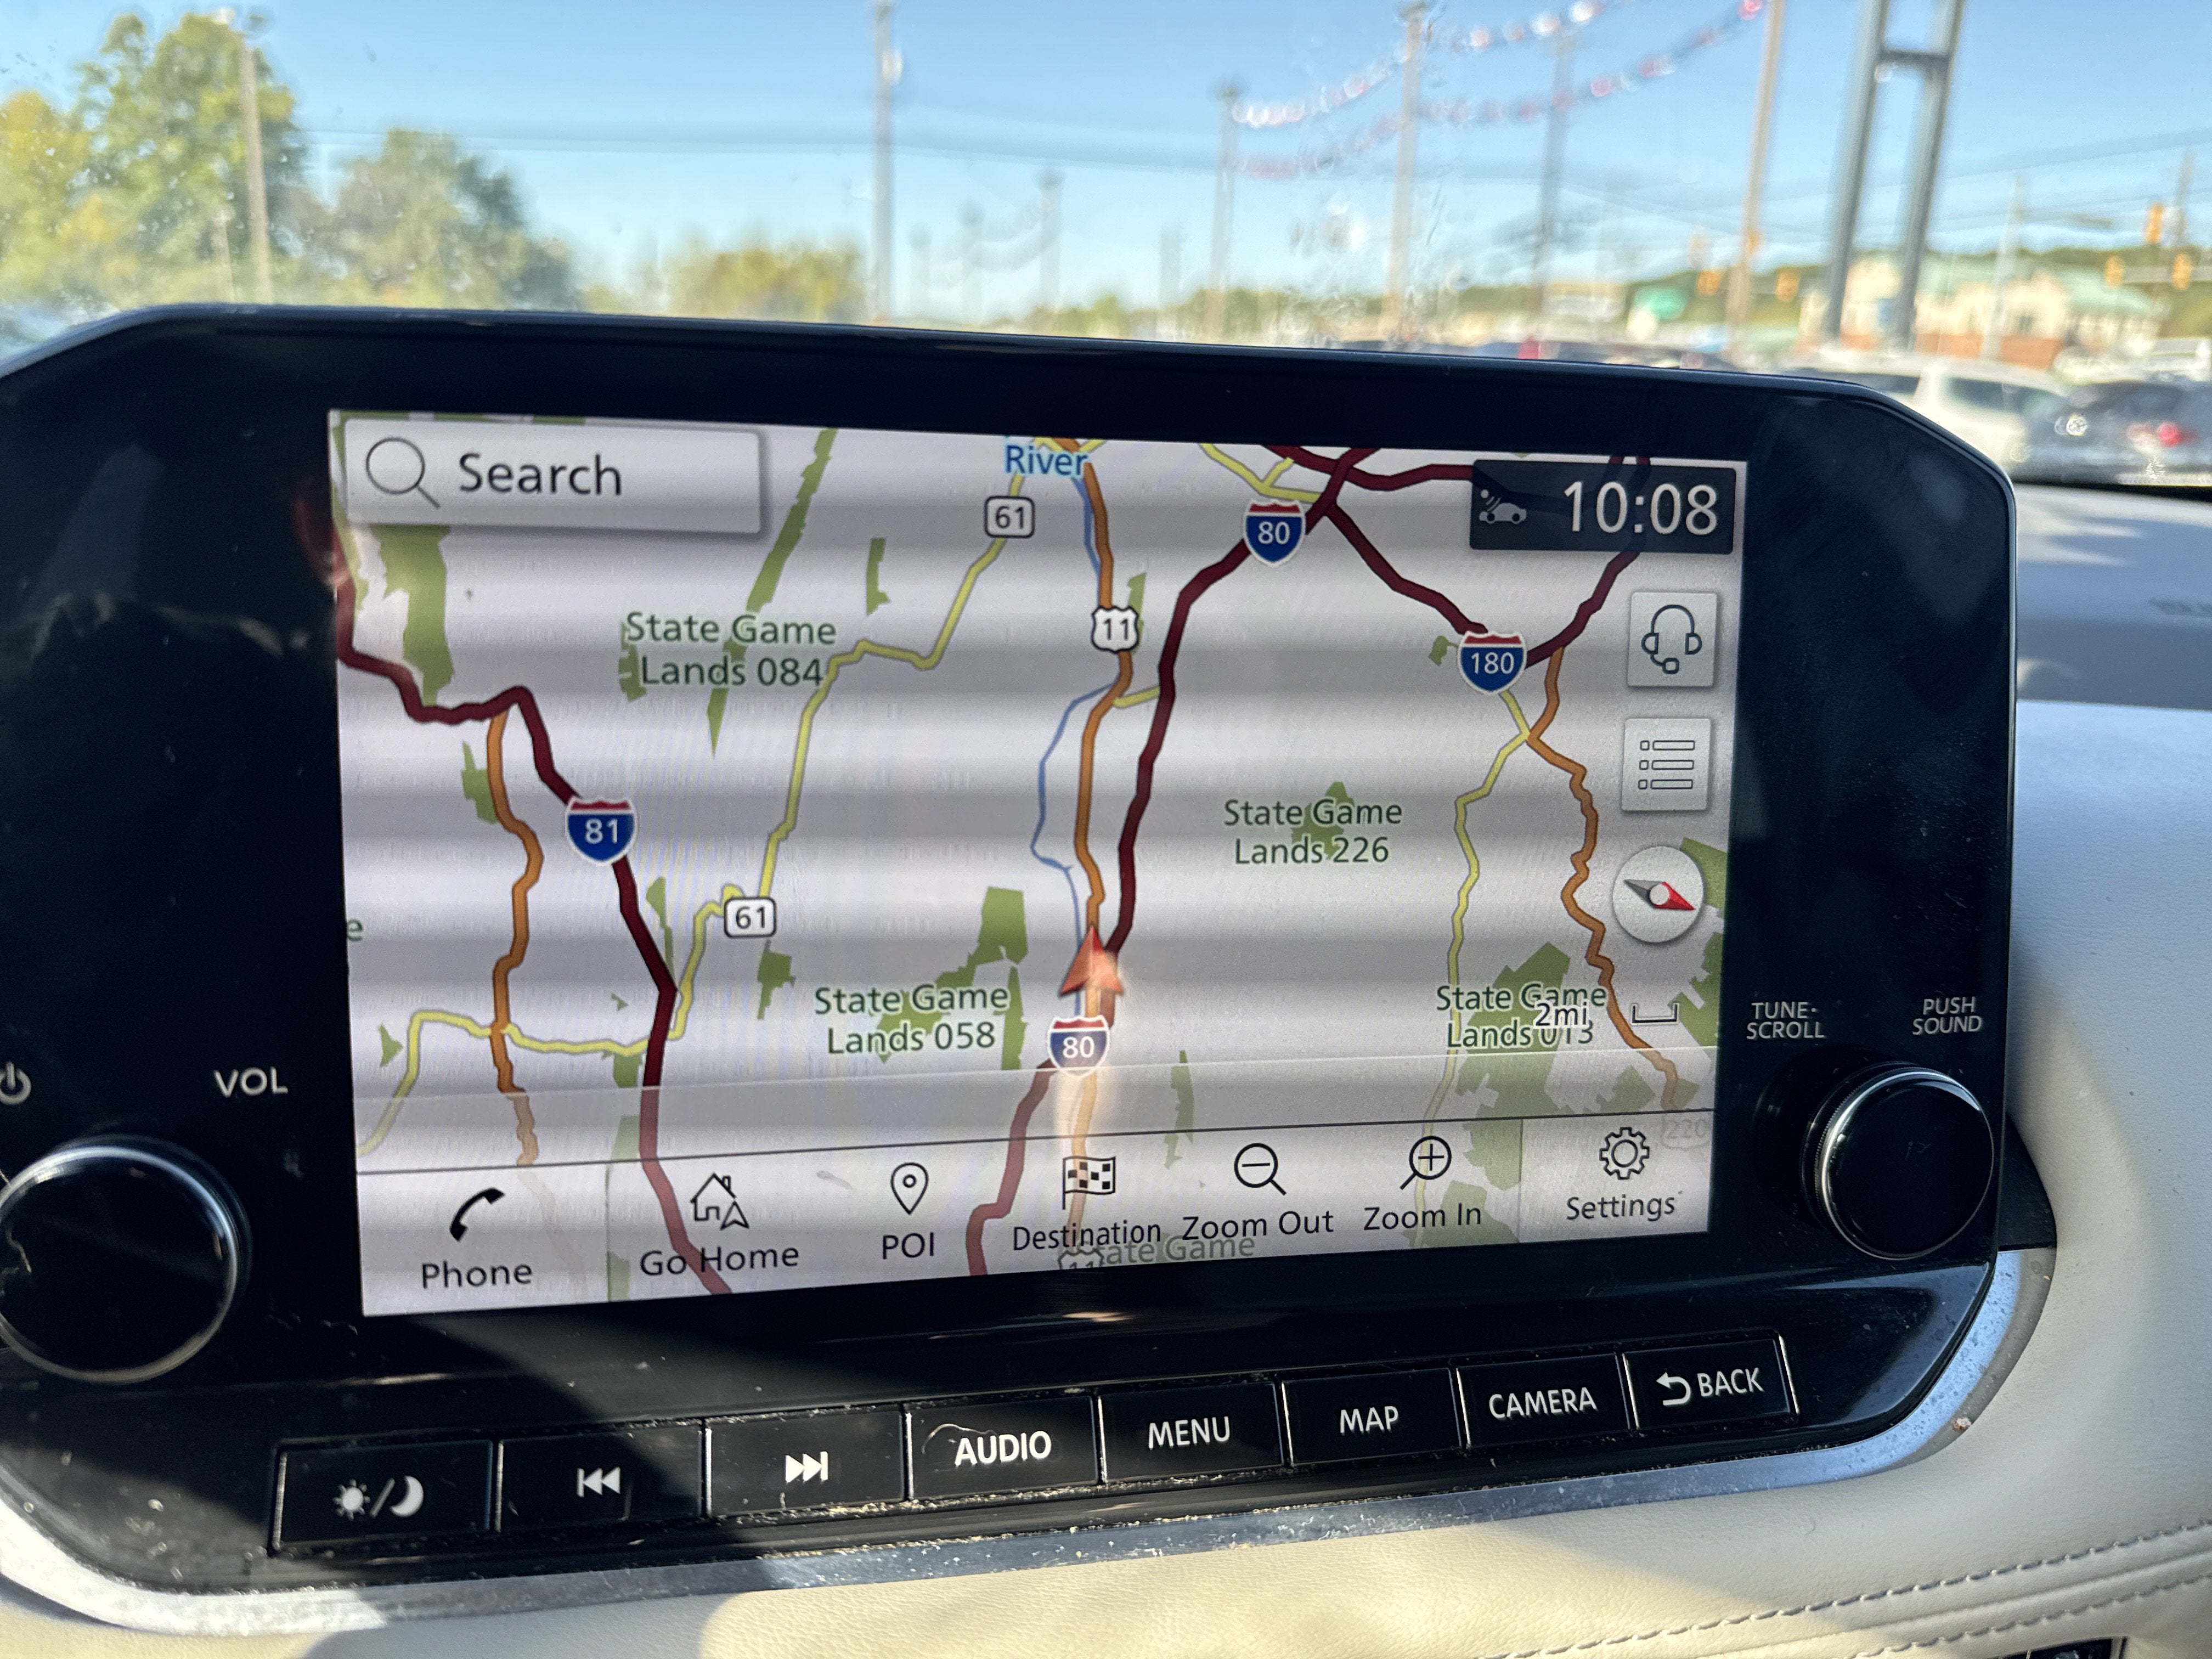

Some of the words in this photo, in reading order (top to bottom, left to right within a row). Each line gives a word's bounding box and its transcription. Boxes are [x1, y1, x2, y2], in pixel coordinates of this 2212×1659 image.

[460, 453, 622, 495] Search
[1006, 445, 1087, 476] River
[996, 506, 1024, 529] 61
[1564, 481, 1717, 535] 10:08
[1258, 521, 1290, 545] 80
[627, 612, 719, 641] State
[732, 614, 836, 644] Game
[1104, 618, 1129, 641] 11
[642, 655, 746, 685] Lands
[758, 657, 823, 686] 084
[1471, 652, 1514, 674] 180
[1224, 799, 1302, 826] State
[1313, 799, 1402, 824] Game
[585, 819, 617, 844] 81
[1235, 836, 1322, 864] Lands
[1334, 837, 1389, 862] 226
[736, 907, 765, 929] 61
[815, 988, 900, 1014] State
[913, 984, 1007, 1010] Game
[1437, 986, 1510, 1011] State
[1522, 983, 1606, 1008] Game
[1923, 997, 1975, 1015] PUSH
[1536, 1002, 1587, 1026] 2mi
[1912, 1016, 1983, 1035] SOUND
[828, 1023, 923, 1054] Lands
[935, 1022, 994, 1049] 058
[1448, 1020, 1531, 1047] Lands
[1747, 1022, 1825, 1040] SCROLL
[1063, 1036, 1094, 1058] 80
[214, 1067, 287, 1097] VOL
[1364, 1207, 1445, 1231] Zoom
[1458, 1204, 1481, 1226] In
[1566, 1194, 1675, 1221] Settings
[1013, 1220, 1161, 1250] Destination
[1183, 1217, 1267, 1240] Zoom
[1279, 1211, 1333, 1234] Out
[883, 1233, 934, 1259] POI
[1166, 1235, 1255, 1261] Game
[422, 1260, 532, 1289] Phone
[640, 1251, 687, 1276] Go
[700, 1248, 799, 1272] Home
[1697, 1367, 1764, 1398] BACK
[1489, 1387, 1596, 1419] CAMERA
[1149, 1416, 1230, 1449] MENU
[1340, 1406, 1399, 1434] MAP
[955, 1431, 1051, 1467] AUDIO
